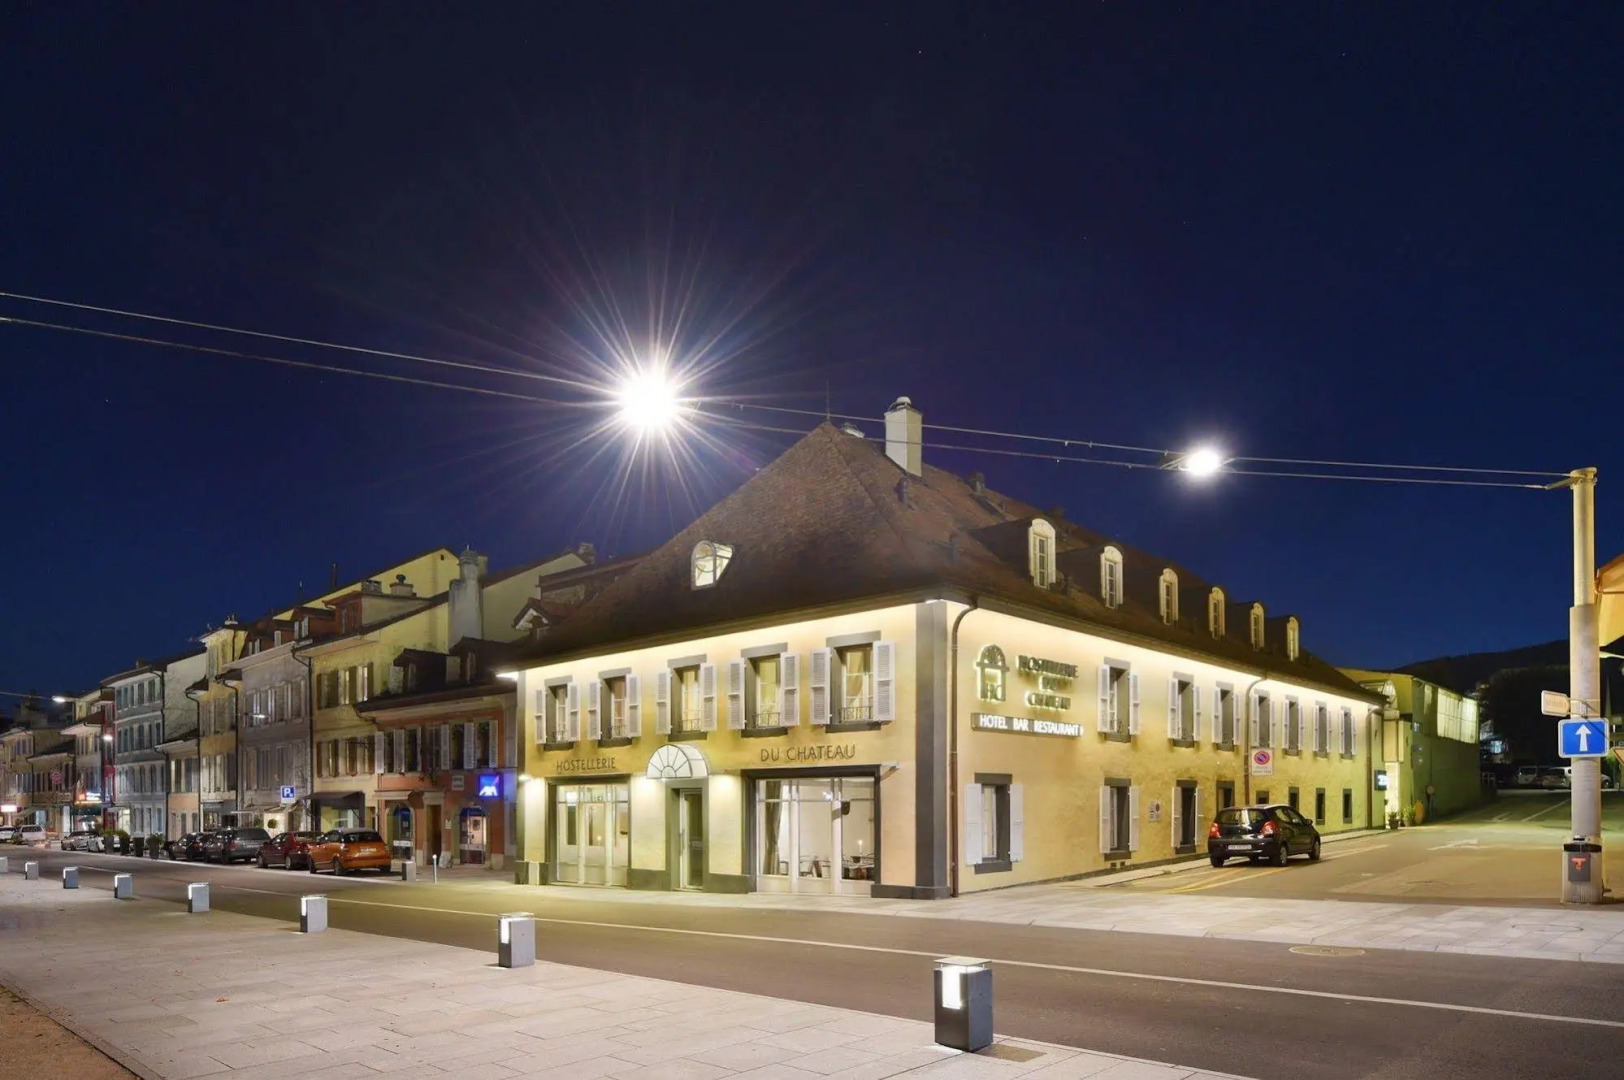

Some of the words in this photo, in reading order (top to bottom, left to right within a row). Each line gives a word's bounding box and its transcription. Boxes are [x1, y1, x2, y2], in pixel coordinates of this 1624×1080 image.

[980, 714, 1007, 729] HOTEL
[1013, 718, 1029, 731] BAR
[1034, 720, 1079, 736] RESTAURANT
[761, 748, 780, 762] DU
[786, 744, 856, 761] CHATEAU
[556, 757, 616, 771] HOSTELLERIE
